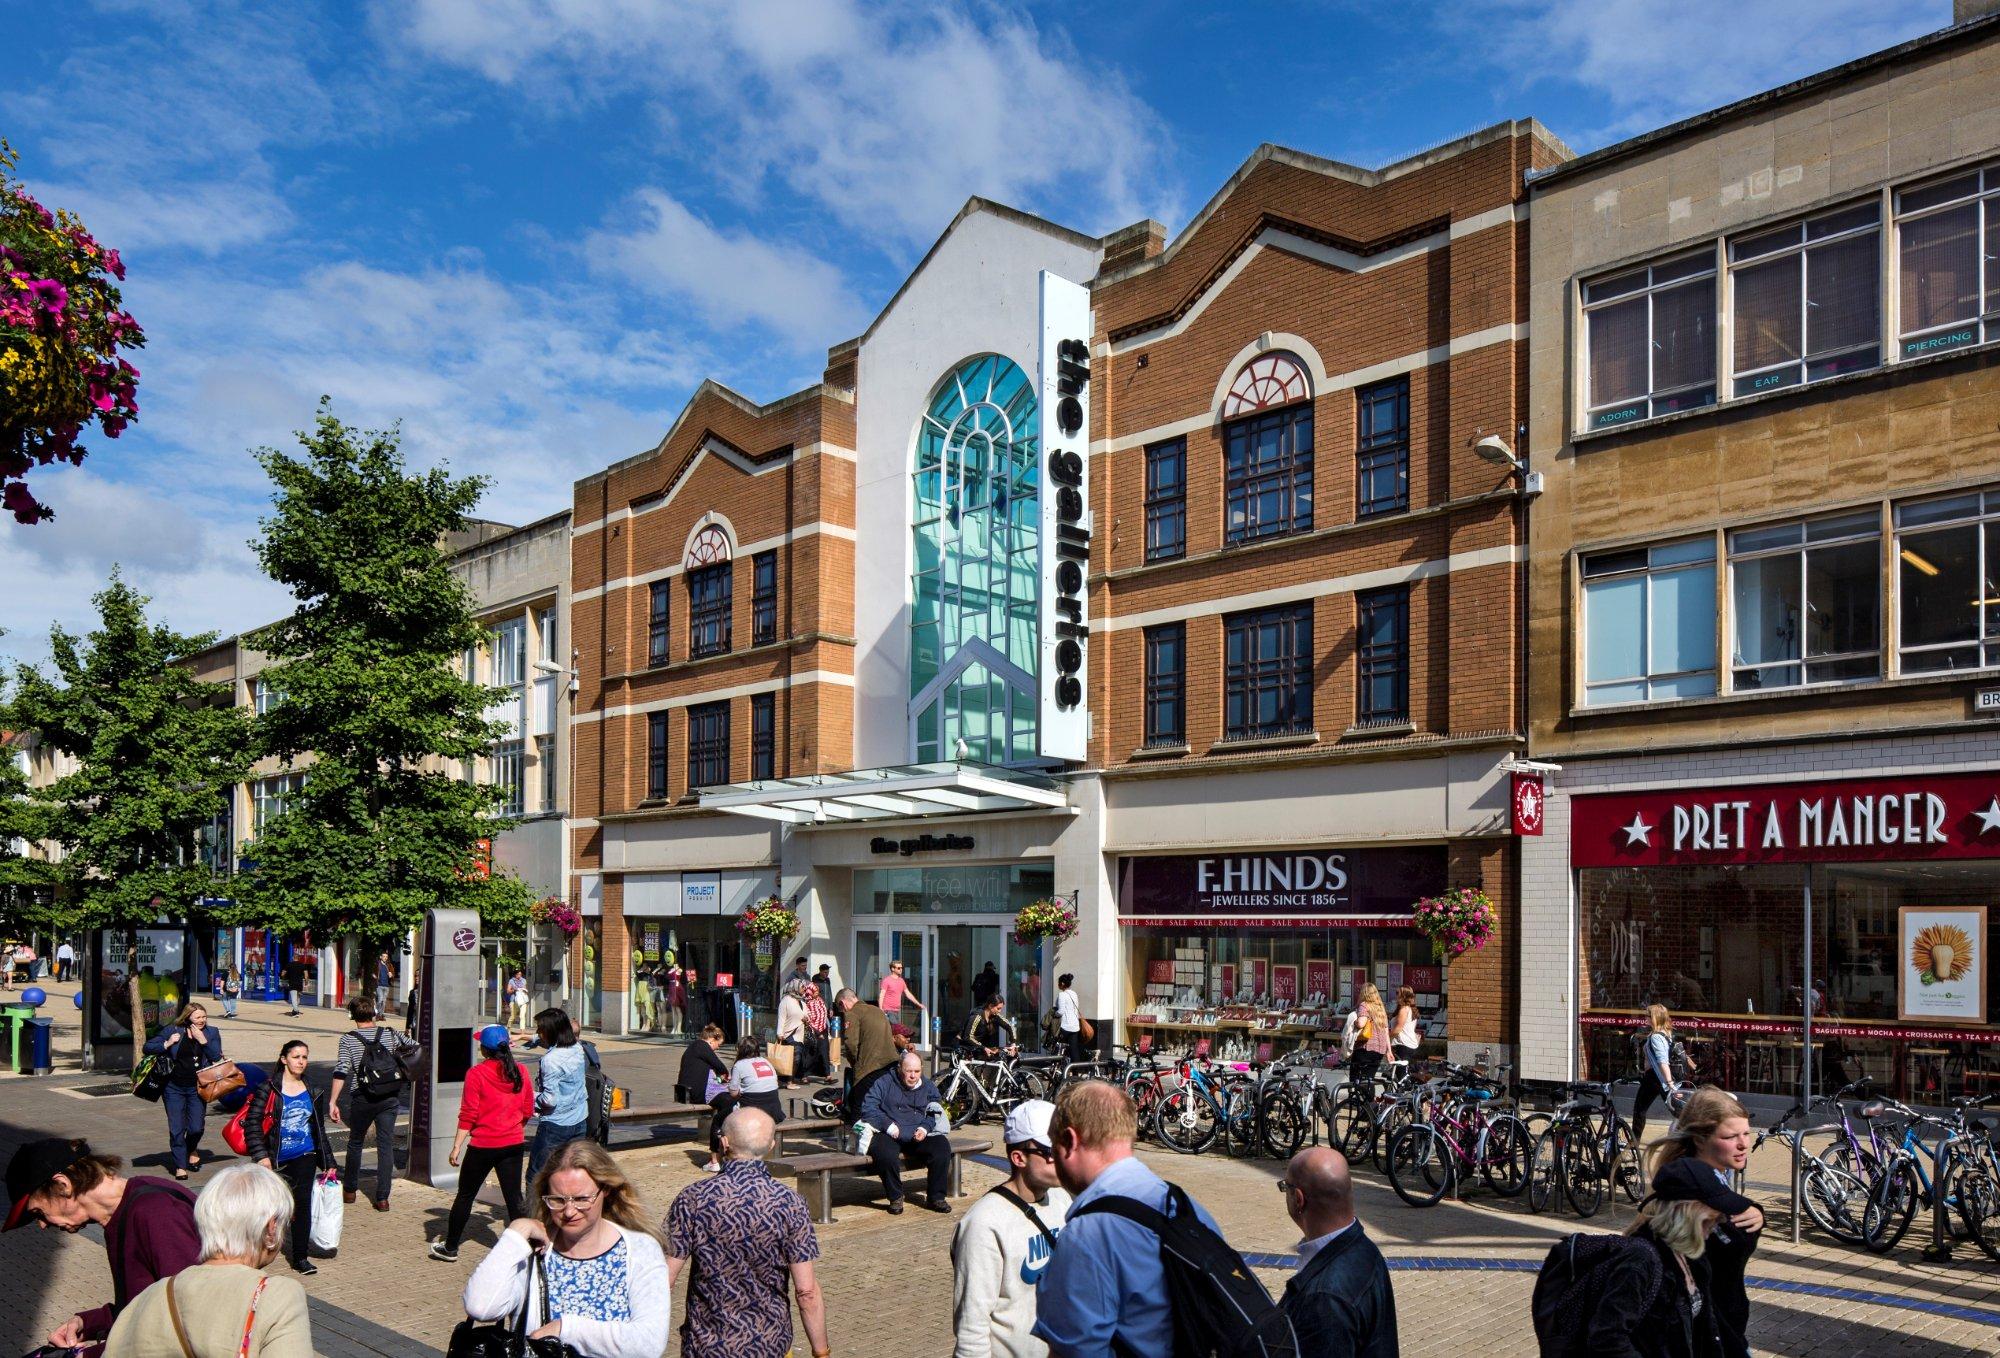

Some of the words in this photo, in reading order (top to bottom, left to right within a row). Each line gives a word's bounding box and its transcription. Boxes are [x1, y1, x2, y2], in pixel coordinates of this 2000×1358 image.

[1906, 331, 1972, 353] PIERCING
[1755, 375, 1779, 388] EAR
[1600, 409, 1637, 423] ADORN
[1048, 447, 1091, 712] galleries
[1673, 801, 1751, 851] PRET
[1761, 799, 1785, 849] A
[1799, 791, 1949, 848] MANGER
[870, 837, 899, 855] the
[900, 833, 975, 857] galleries
[1198, 854, 1348, 893] F.HINDS
[686, 886, 715, 895] PROJECT
[923, 872, 962, 898] free
[968, 870, 1000, 898] wifi
[1212, 895, 1270, 908] JEWELLERS
[1273, 895, 1307, 906] SINCE
[1310, 894, 1336, 906] 1856
[110, 945, 157, 954] REFRHING
[1611, 920, 1646, 973] PRET
[138, 955, 156, 963] KICK
[1309, 981, 1330, 989] SALE
[1708, 1022, 1741, 1030] ESPRESSO
[1905, 1031, 1953, 1040] CROISSANTS
[418, 1000, 431, 1131] Infortion
